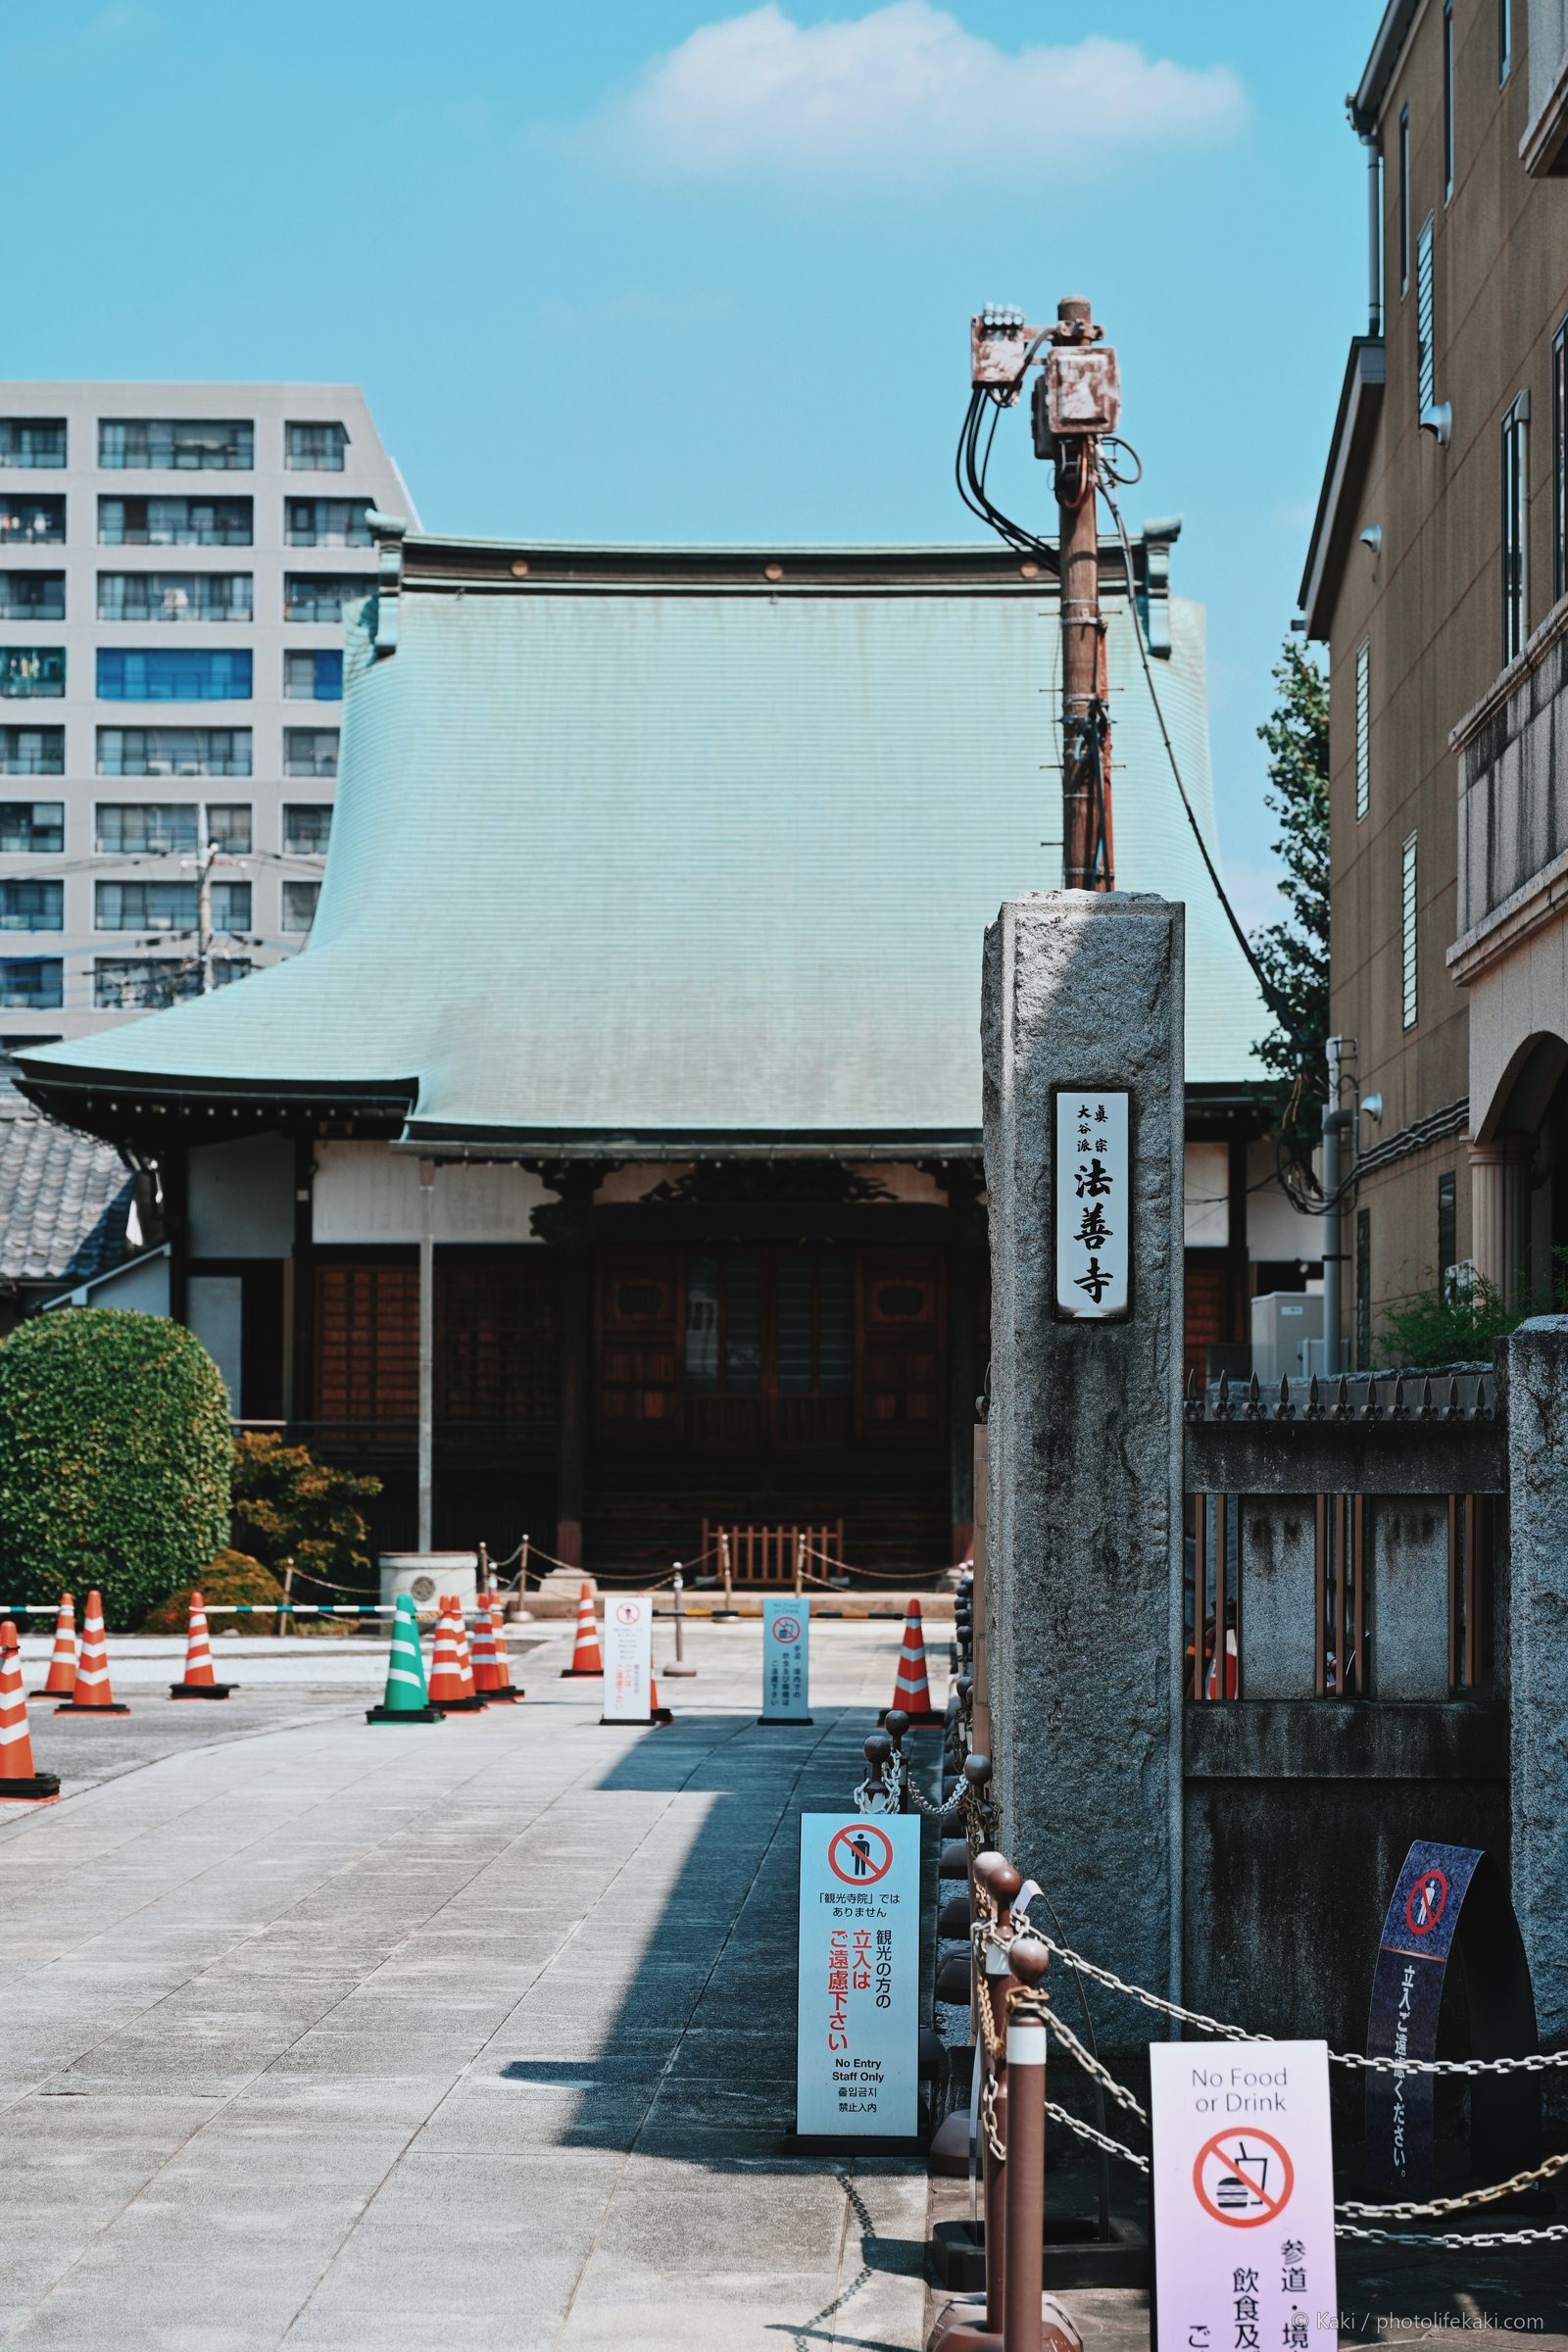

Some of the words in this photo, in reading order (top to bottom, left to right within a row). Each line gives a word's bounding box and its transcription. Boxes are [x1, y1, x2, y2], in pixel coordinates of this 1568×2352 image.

[1076, 1104, 1093, 1152] 大谷派
[1073, 1158, 1114, 1304] 法善寺
[819, 1892, 901, 1904] 「観光寺院」では
[832, 1906, 887, 1918] ありません
[852, 1930, 872, 1989] 立入は
[875, 1930, 892, 2009] 観光の方の
[828, 1931, 849, 2051] ご遠慮下さい
[835, 2059, 851, 2068] No
[854, 2059, 881, 2070] Entry
[832, 2072, 858, 2082] Staff
[860, 2072, 884, 2082] Only
[1192, 2069, 1223, 2087] No
[1231, 2067, 1288, 2086] Food
[838, 2087, 877, 2098] 출입금지
[1196, 2098, 1217, 2112] or
[1226, 2091, 1287, 2112] Drink
[838, 2102, 877, 2113] 禁止入内
[1281, 2239, 1309, 2352] 参道・境
[1233, 2267, 1260, 2352] 飲食及
[1188, 2326, 1210, 2352] ご
